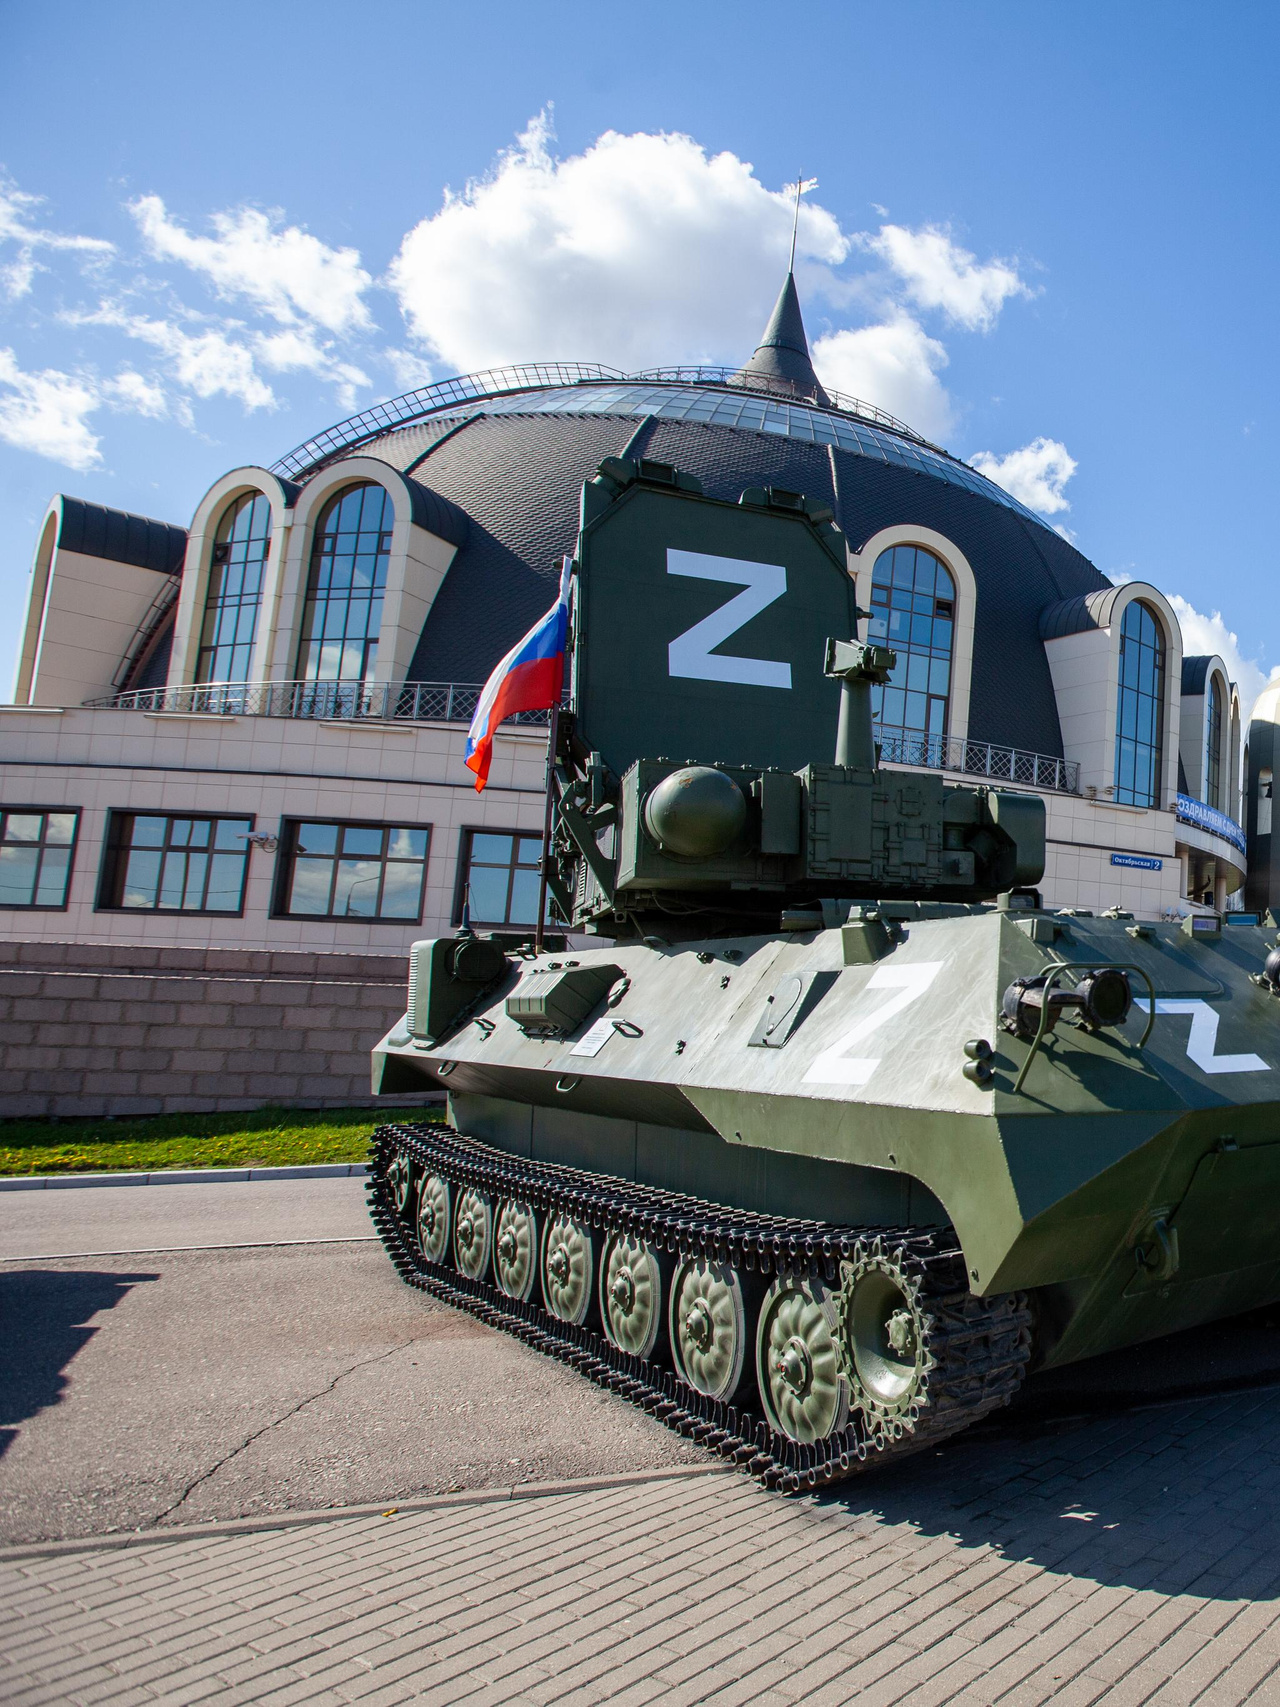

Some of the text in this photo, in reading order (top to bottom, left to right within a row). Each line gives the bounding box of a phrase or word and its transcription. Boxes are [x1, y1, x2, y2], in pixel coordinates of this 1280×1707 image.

[667, 548, 792, 689] Z
[1115, 856, 1160, 870] Октябрьская 2
[801, 961, 945, 1085] Z
[1133, 998, 1272, 1073] Z
